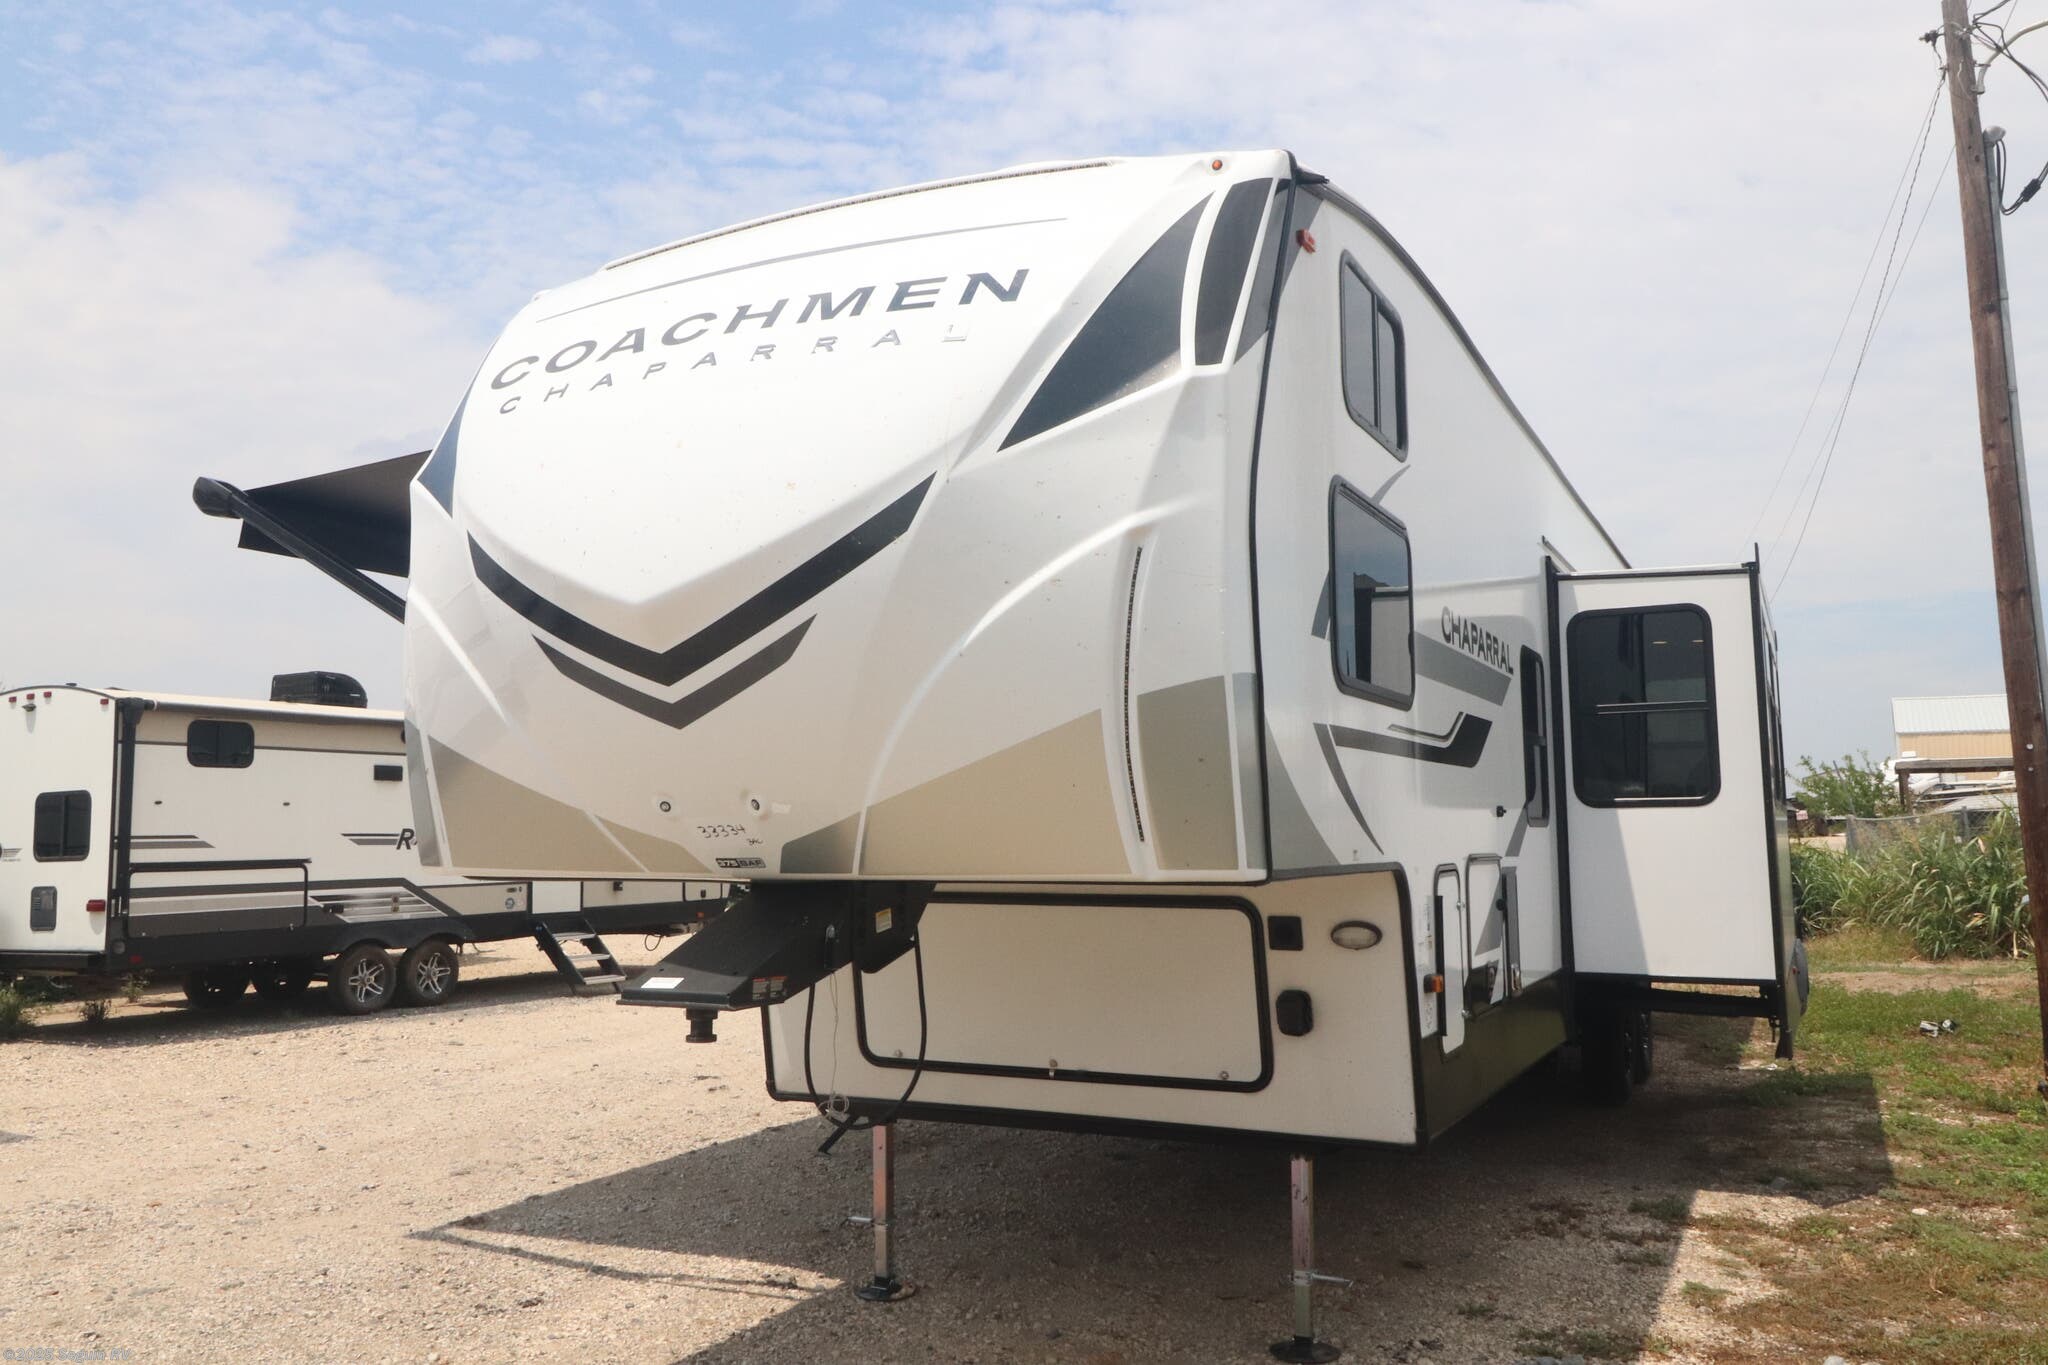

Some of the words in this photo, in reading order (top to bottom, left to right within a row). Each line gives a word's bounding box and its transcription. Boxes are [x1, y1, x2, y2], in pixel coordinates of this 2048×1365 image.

[490, 269, 1031, 391] COACHMEN
[499, 324, 970, 415] CHAPARRAL
[1441, 605, 1514, 676] CHAPARRAL
